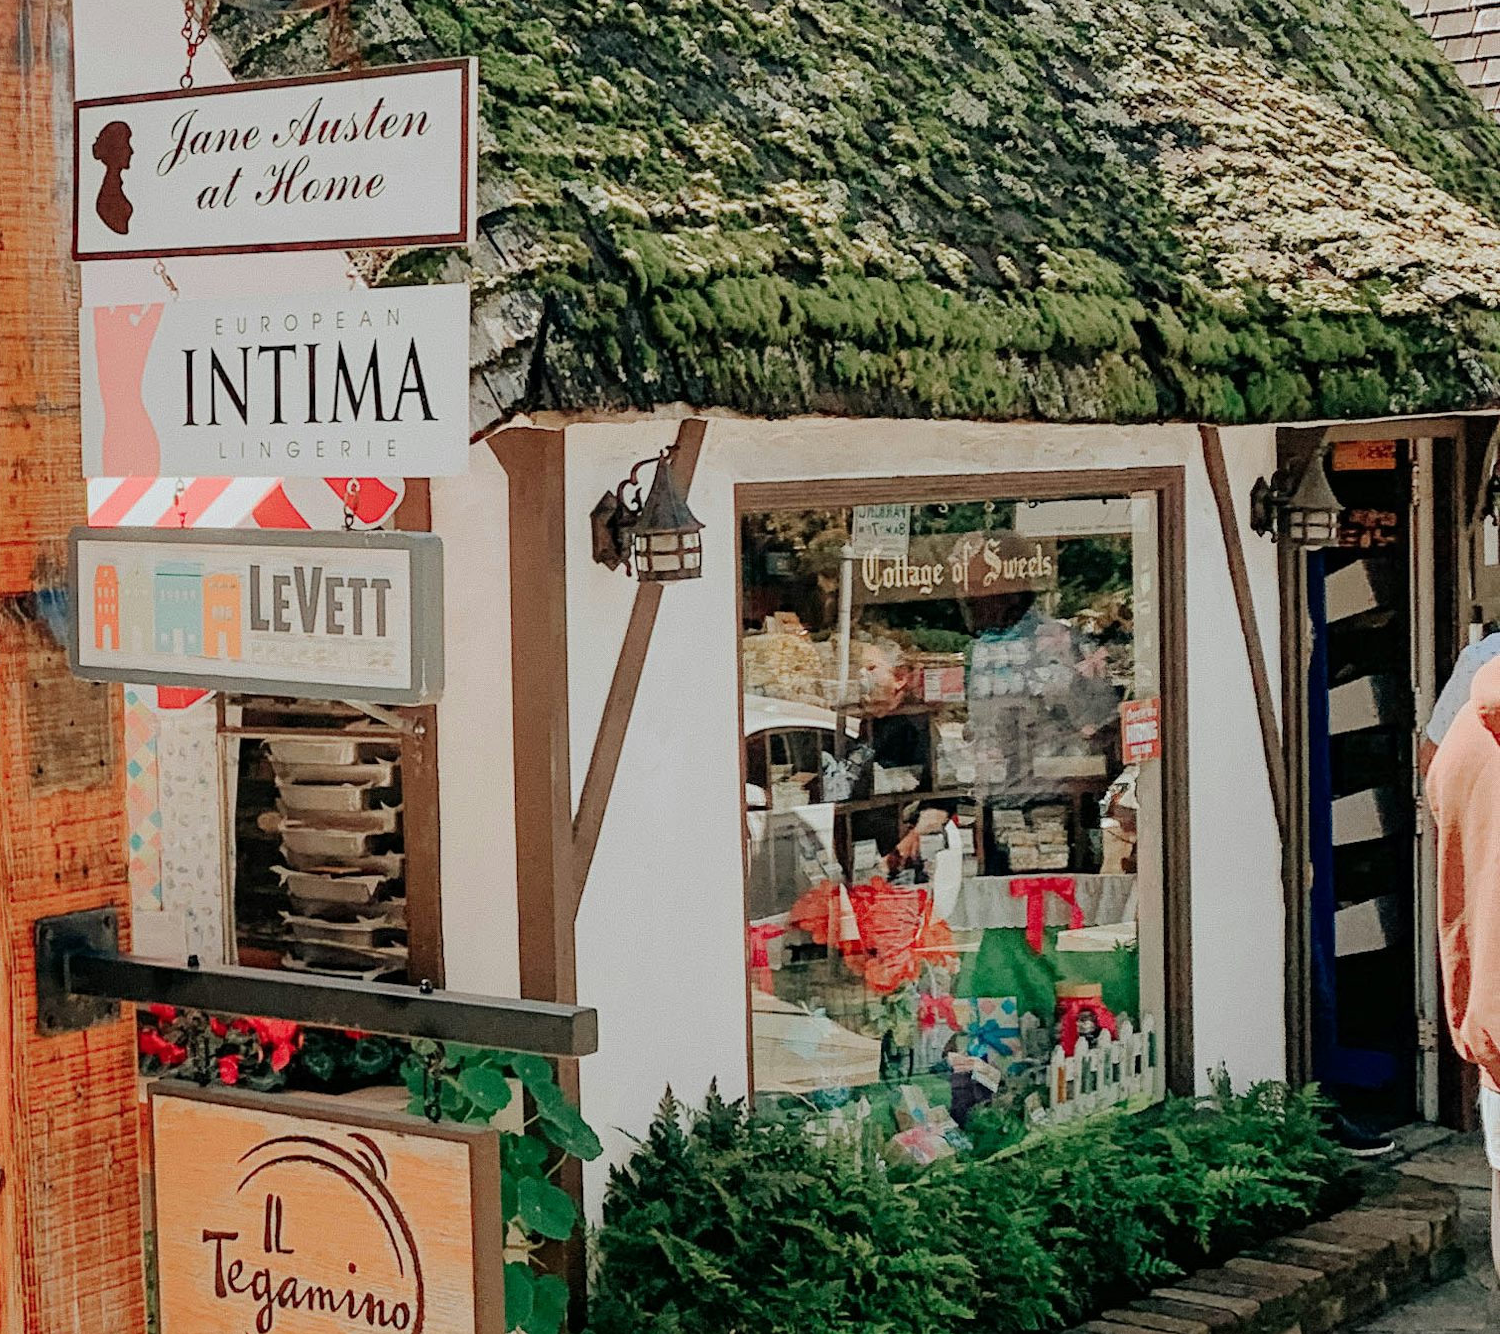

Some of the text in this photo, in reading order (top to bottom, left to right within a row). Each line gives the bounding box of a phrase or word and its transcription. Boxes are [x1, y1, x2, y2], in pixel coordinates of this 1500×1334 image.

[156, 96, 432, 177] Jane Austen
[195, 155, 386, 210] at Home
[214, 308, 401, 336] EUROPEAN
[180, 335, 439, 427] INTIMA
[218, 439, 398, 460] LINGERIE
[861, 538, 1053, 596] Cottage of Sweets
[201, 1228, 412, 1334] Tegamino
